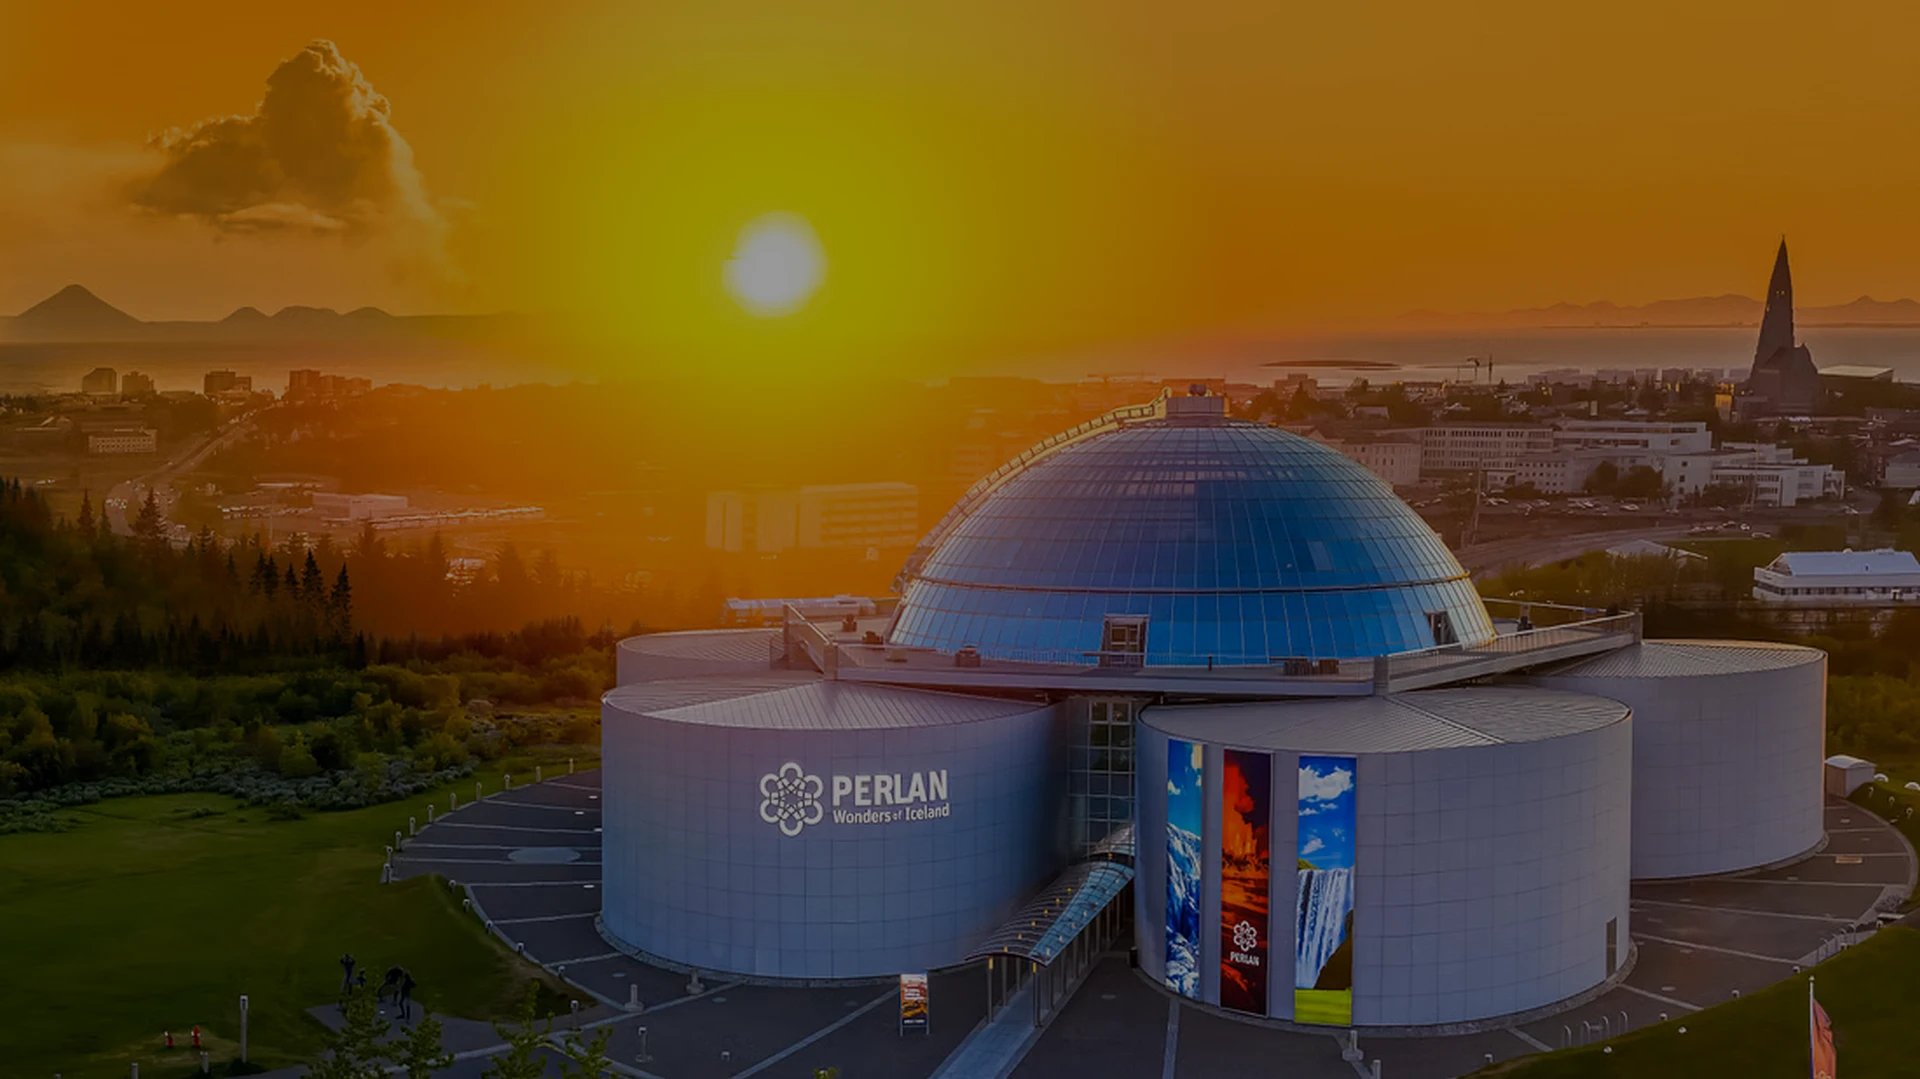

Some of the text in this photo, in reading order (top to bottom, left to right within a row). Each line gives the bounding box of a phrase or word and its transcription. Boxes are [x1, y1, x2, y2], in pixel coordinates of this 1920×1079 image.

[832, 769, 948, 806] PERLAN
[833, 803, 950, 824] Wonders of Iceland
[1230, 951, 1260, 966] PERLAN
